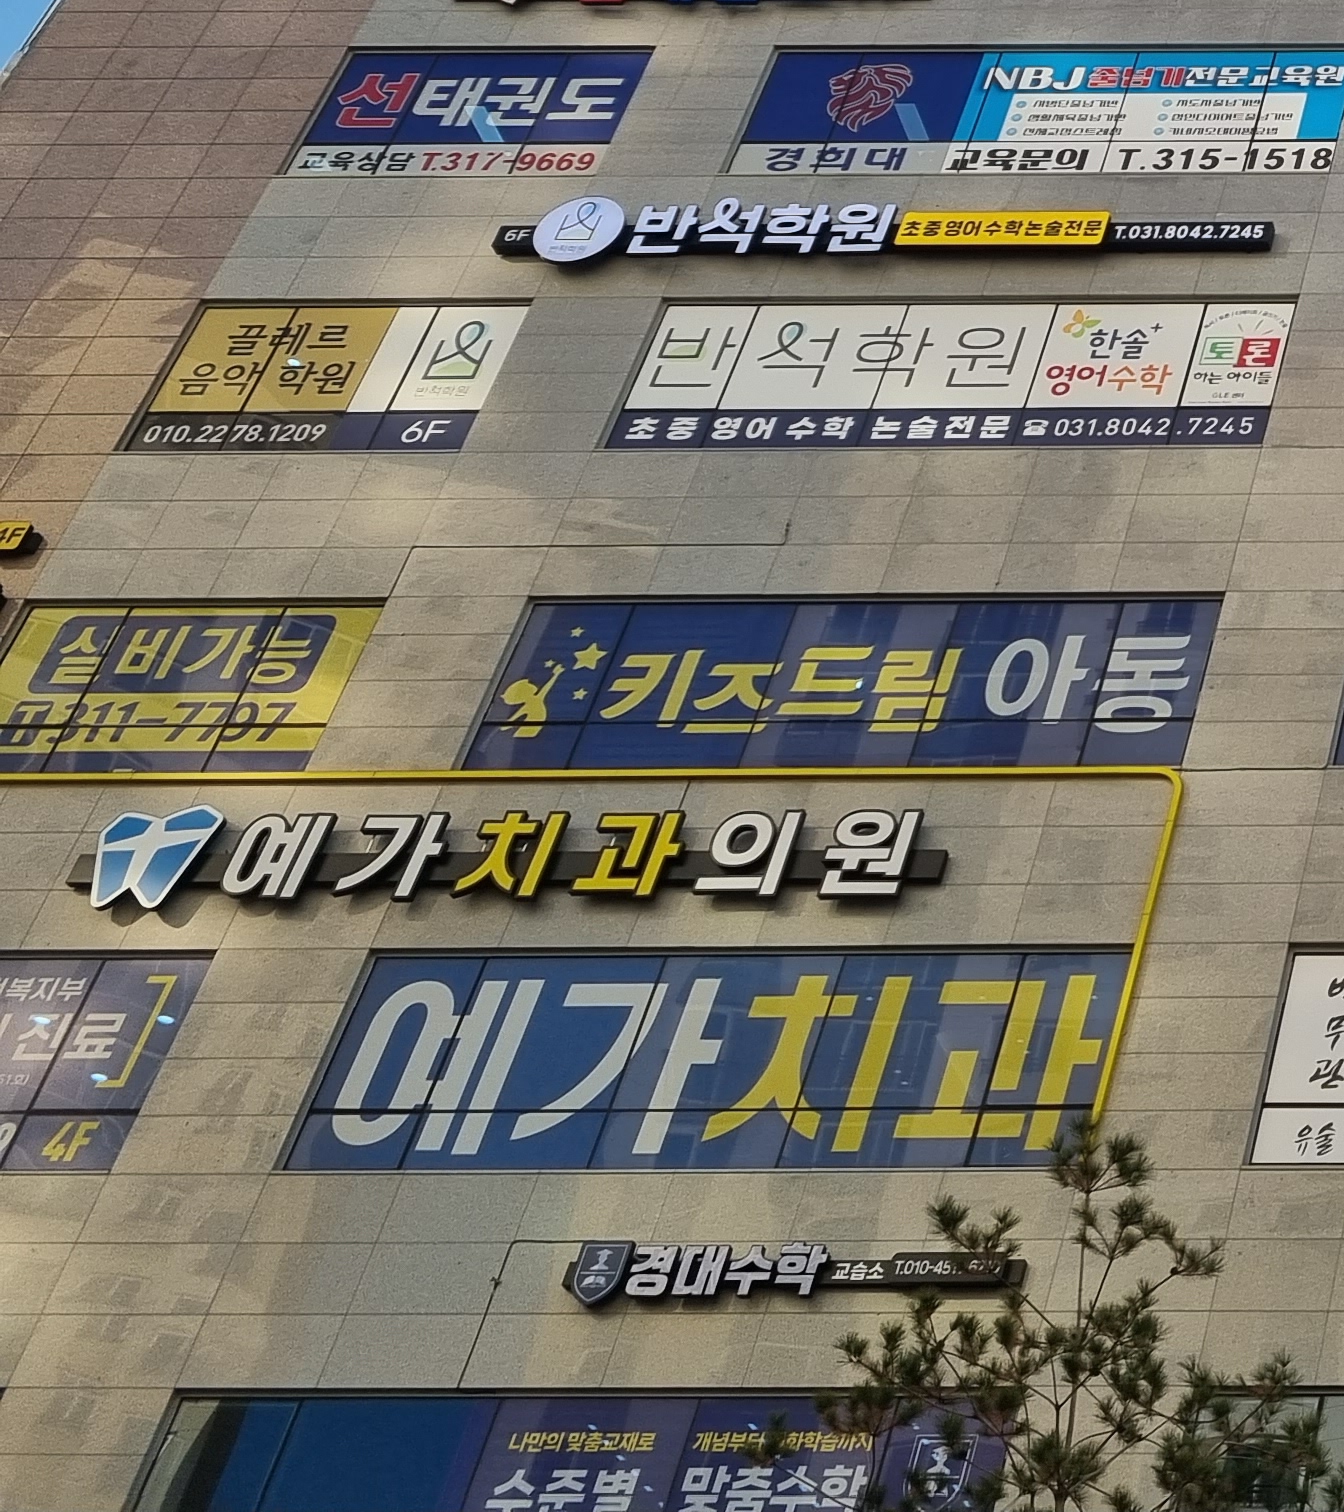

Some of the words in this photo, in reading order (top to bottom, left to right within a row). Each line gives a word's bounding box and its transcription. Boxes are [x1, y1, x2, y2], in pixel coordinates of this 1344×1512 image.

[336, 72, 625, 129] 선태권도
[297, 150, 416, 175] 교육상담
[420, 151, 597, 173] T.317-9669
[764, 146, 909, 173] 경희대
[944, 147, 1090, 172] 교육문의
[1117, 146, 1333, 172] T.315-1518
[504, 228, 533, 242] 6F
[626, 200, 899, 256] 반석학원
[1113, 224, 1265, 240] T.031.8042.7245
[646, 322, 1028, 388] 반석학원
[1203, 340, 1272, 367] 토론
[1044, 364, 1173, 397] 영어수학
[142, 423, 327, 444] 010.2278.1209
[400, 419, 453, 444] 6F
[710, 415, 774, 441] 영어
[785, 415, 855, 441] 수학
[1053, 415, 1255, 438] 031.8042.7245
[47, 624, 314, 686] 실비가능
[599, 645, 965, 736] 키즈드림
[983, 632, 1193, 735] 아동
[46, 700, 299, 745] 311-7797
[220, 808, 925, 902] 예가치과의원
[331, 974, 1104, 1156] 예가치과
[40, 1121, 101, 1162] 4F
[625, 1241, 828, 1298] 경대수학
[830, 1261, 886, 1281] 교습소
[507, 1432, 566, 1452] 나만의
[567, 1431, 655, 1452] 맞춤교재로
